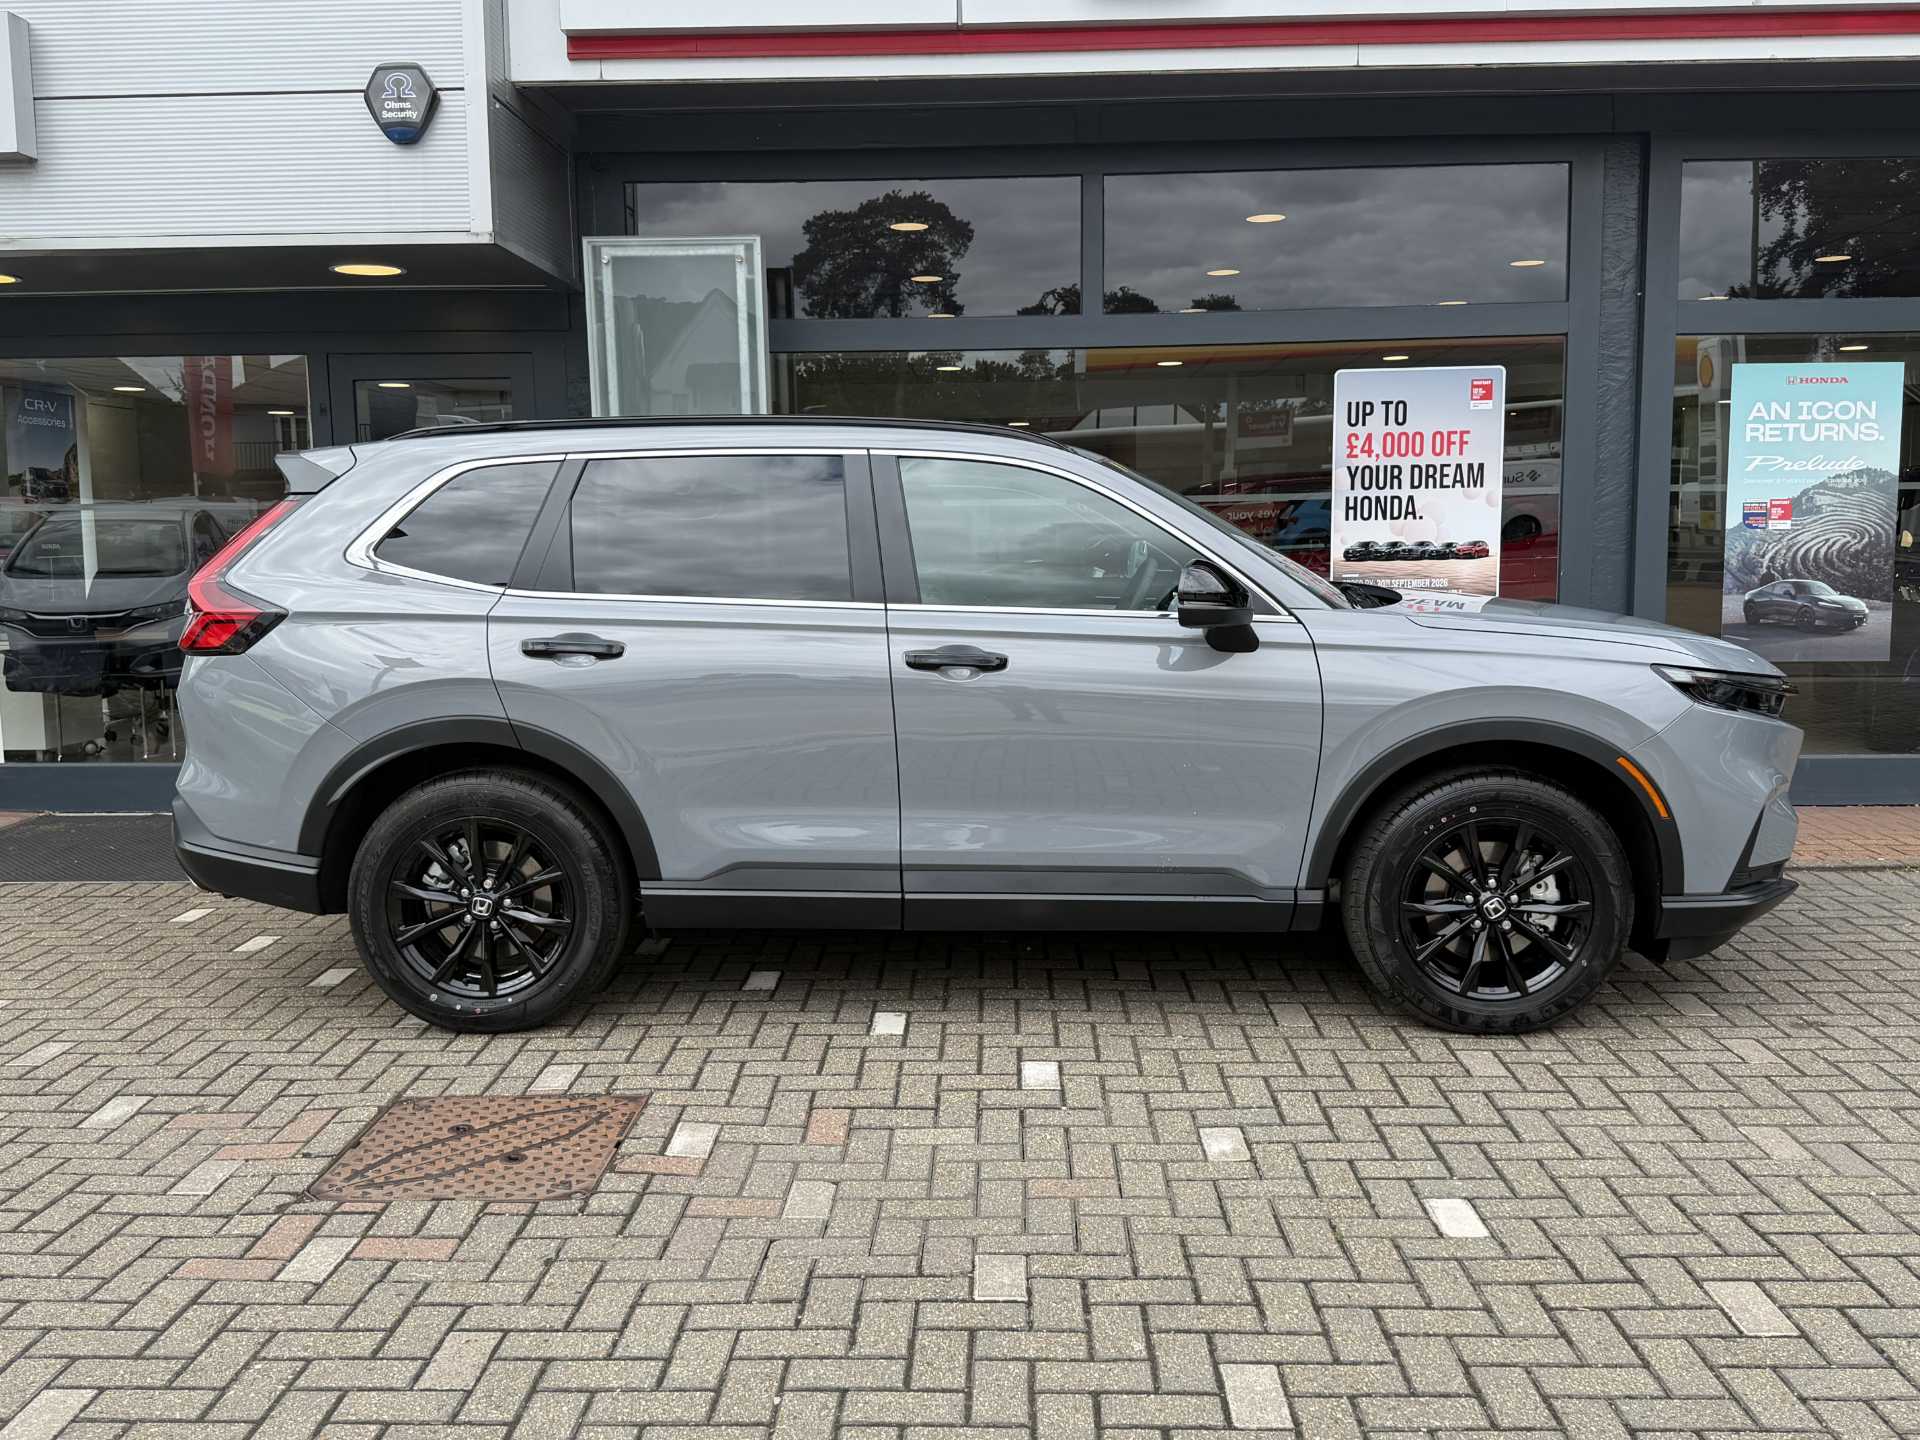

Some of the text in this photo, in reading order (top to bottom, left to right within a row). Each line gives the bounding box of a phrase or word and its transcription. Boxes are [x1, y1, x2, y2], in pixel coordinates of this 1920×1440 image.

[382, 110, 418, 119] Security
[384, 101, 411, 109] Ohms
[1346, 400, 1408, 427] UP TO
[1748, 400, 1877, 421] AN ICON
[17, 414, 66, 429] Accessories
[1745, 422, 1886, 443] RETURNS.
[1345, 430, 1472, 462] £4,000 OFF
[1743, 455, 1868, 472] Prelude
[1346, 462, 1486, 491] YOUR DREAM
[1345, 495, 1424, 522] HONDA.
[1391, 579, 1430, 588] SEPTEMBER
